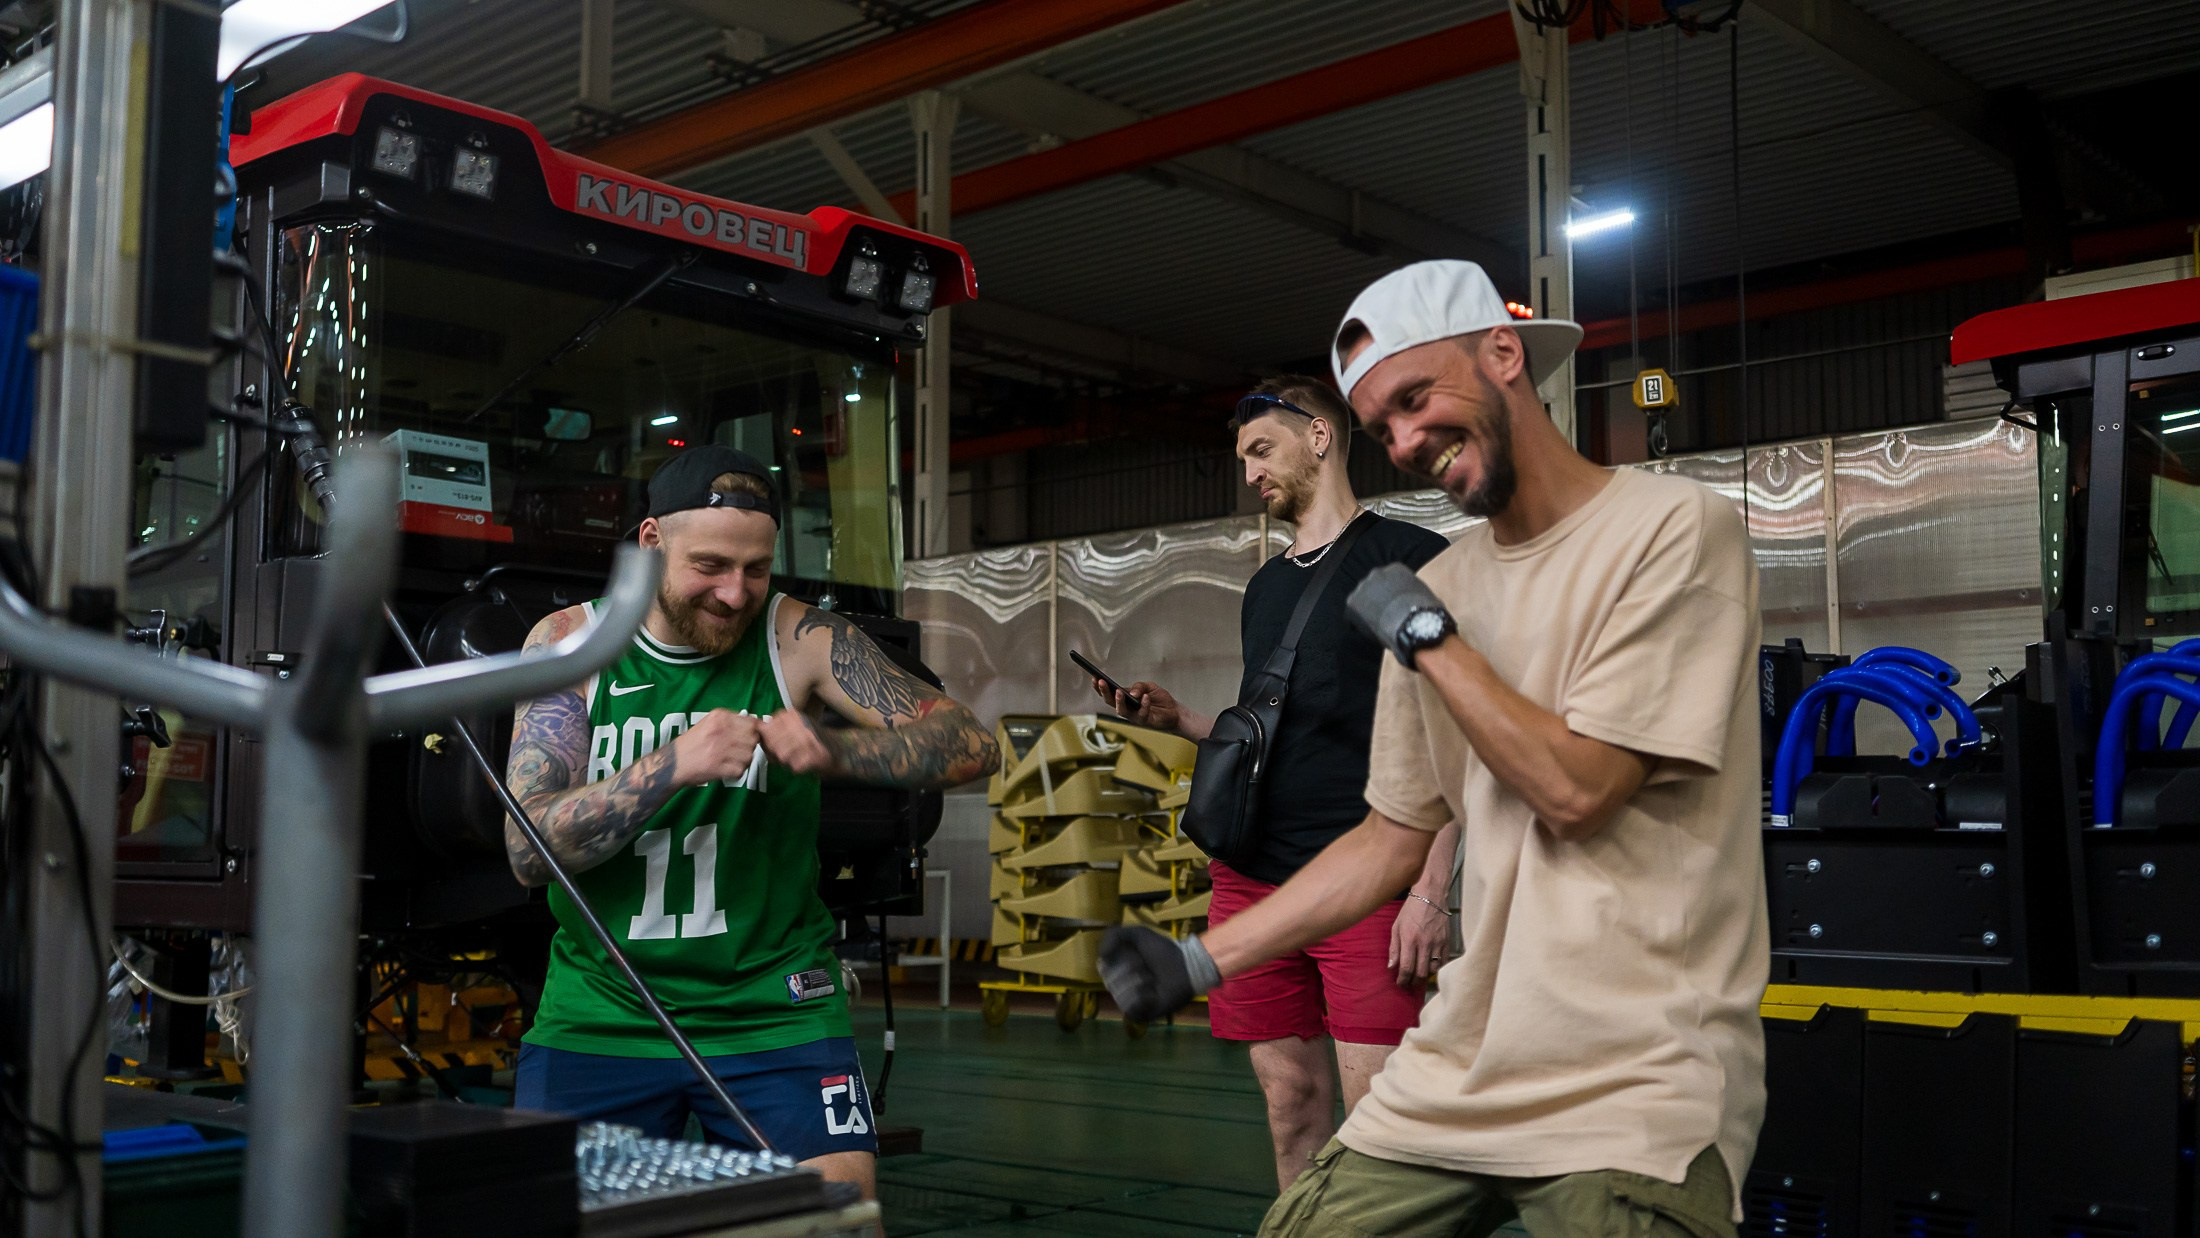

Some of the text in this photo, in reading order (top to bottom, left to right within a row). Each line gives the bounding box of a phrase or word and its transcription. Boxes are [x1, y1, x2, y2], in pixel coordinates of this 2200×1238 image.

[576, 173, 807, 269] КИРОВЕЦ
[627, 822, 728, 940] 11
[820, 1074, 869, 1136] FILA
